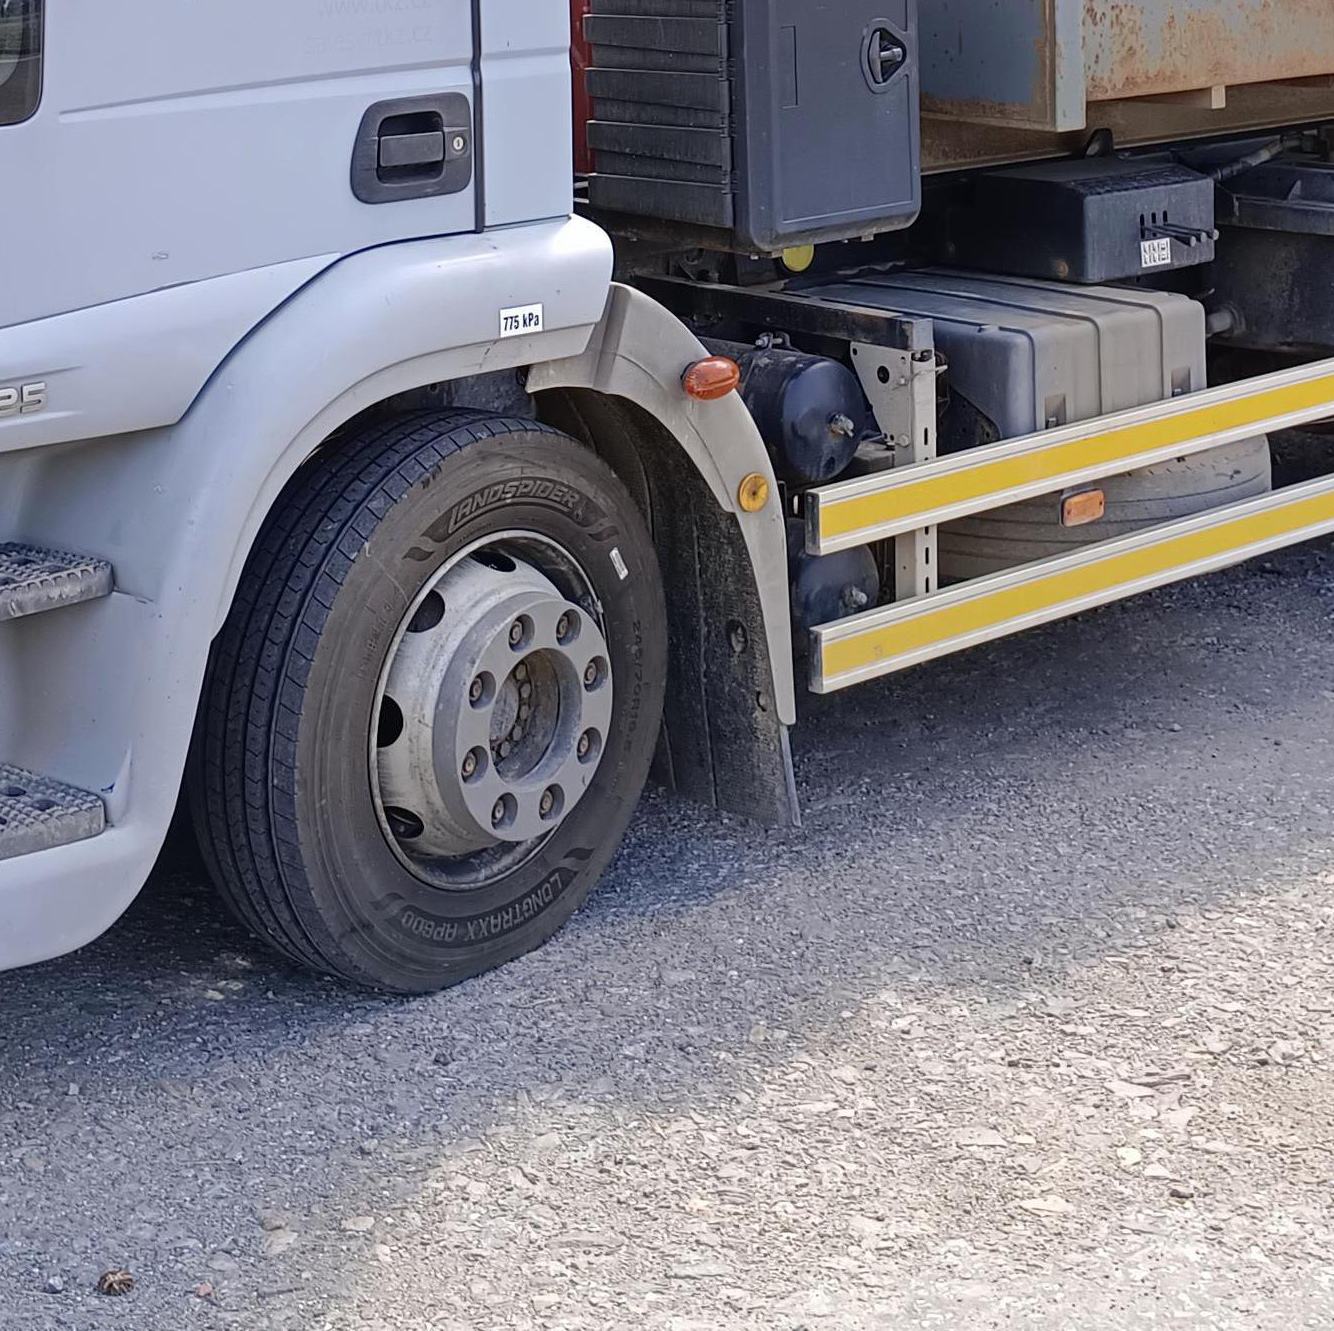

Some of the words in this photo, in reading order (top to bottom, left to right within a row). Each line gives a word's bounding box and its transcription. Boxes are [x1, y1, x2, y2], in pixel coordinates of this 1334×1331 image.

[503, 314, 520, 331] 775
[522, 312, 540, 328] kPa
[448, 480, 580, 534] LANDSPIDER
[464, 872, 562, 942] LONGTRAXX
